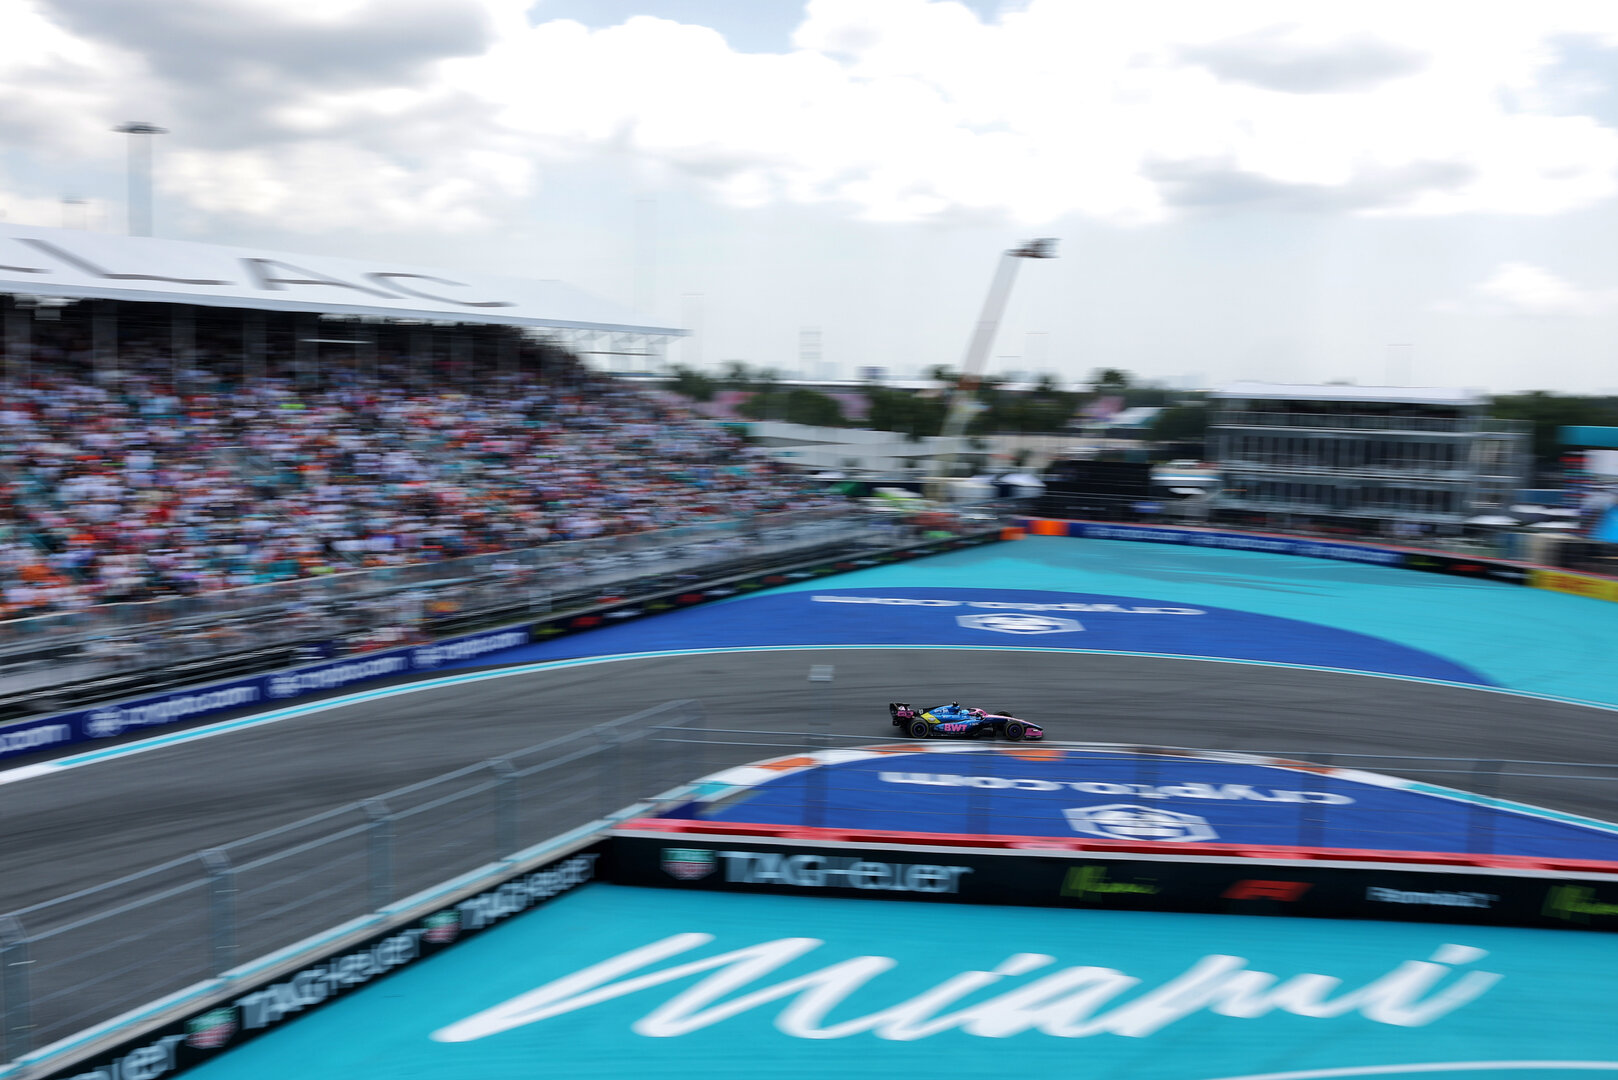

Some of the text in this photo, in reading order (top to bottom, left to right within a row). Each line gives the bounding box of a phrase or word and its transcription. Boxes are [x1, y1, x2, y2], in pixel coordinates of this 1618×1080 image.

[944, 723, 968, 733] BWT
[878, 771, 1356, 805] crypto.com
[428, 931, 1505, 1041] Miami
